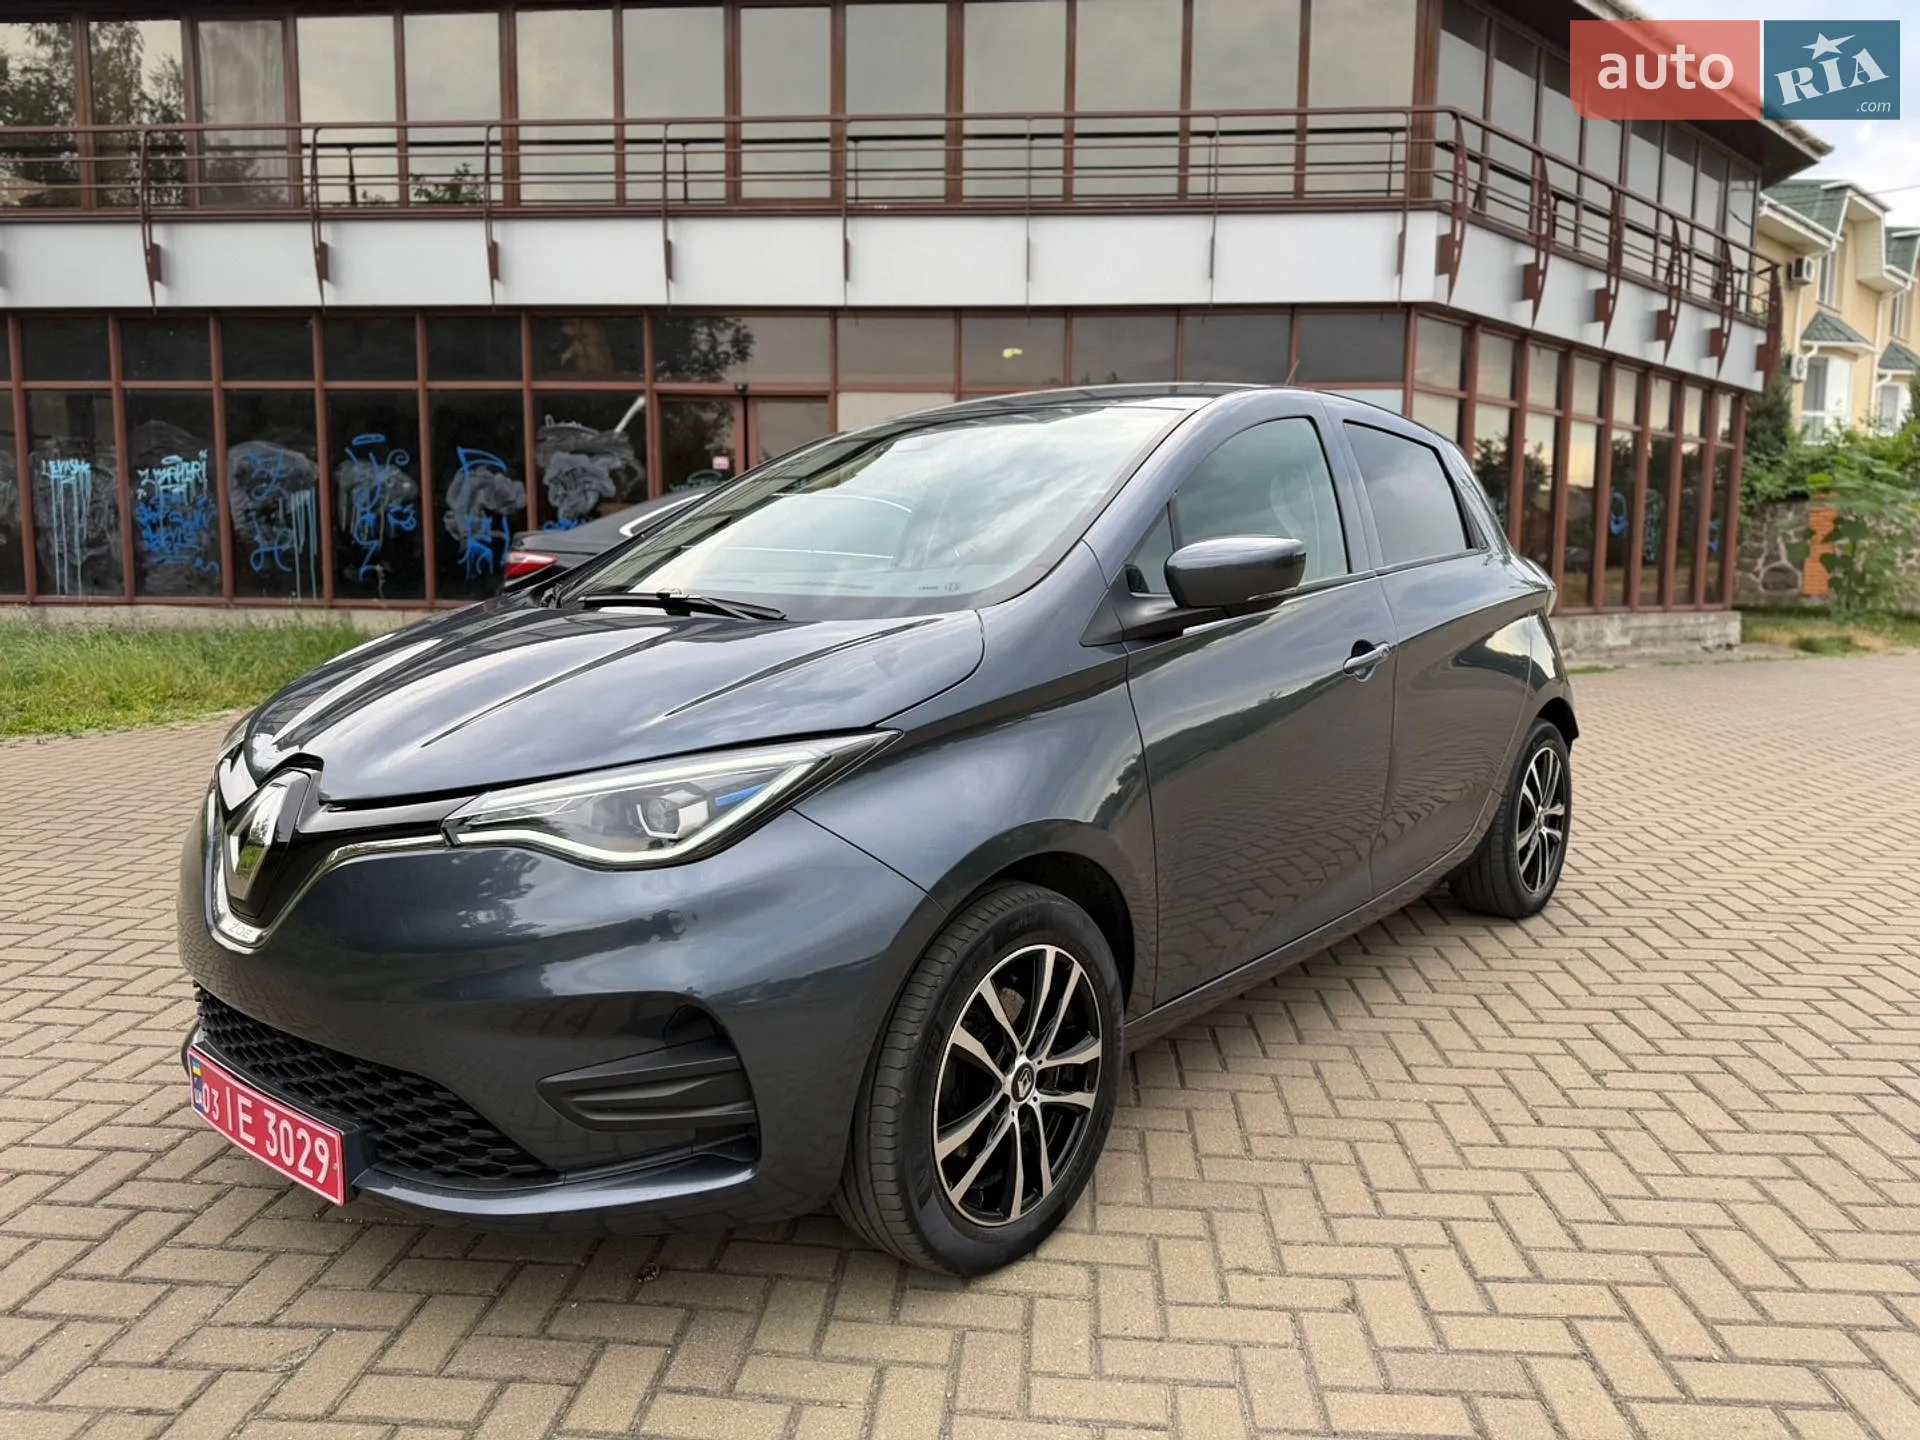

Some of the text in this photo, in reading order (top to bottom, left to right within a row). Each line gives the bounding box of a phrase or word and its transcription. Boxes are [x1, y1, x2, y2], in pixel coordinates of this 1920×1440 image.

[202, 1083, 330, 1185] 03 IE 3029
